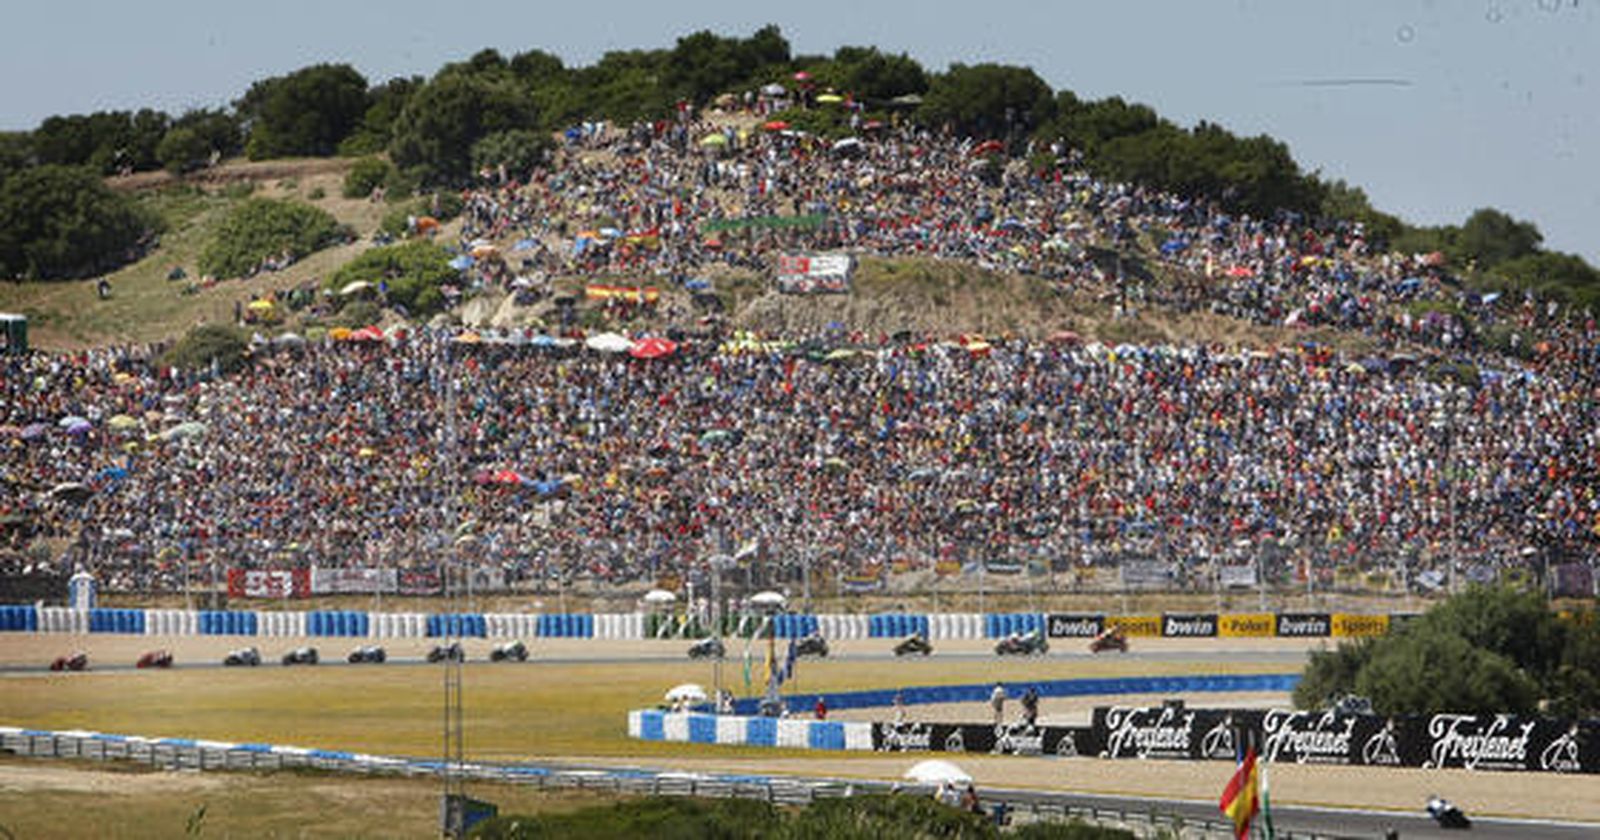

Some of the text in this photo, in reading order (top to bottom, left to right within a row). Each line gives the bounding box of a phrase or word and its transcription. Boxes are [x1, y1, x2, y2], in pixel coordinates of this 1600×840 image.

[1052, 617, 1099, 636] bwin
[1165, 617, 1212, 636] bwin
[1279, 617, 1326, 634] bwin
